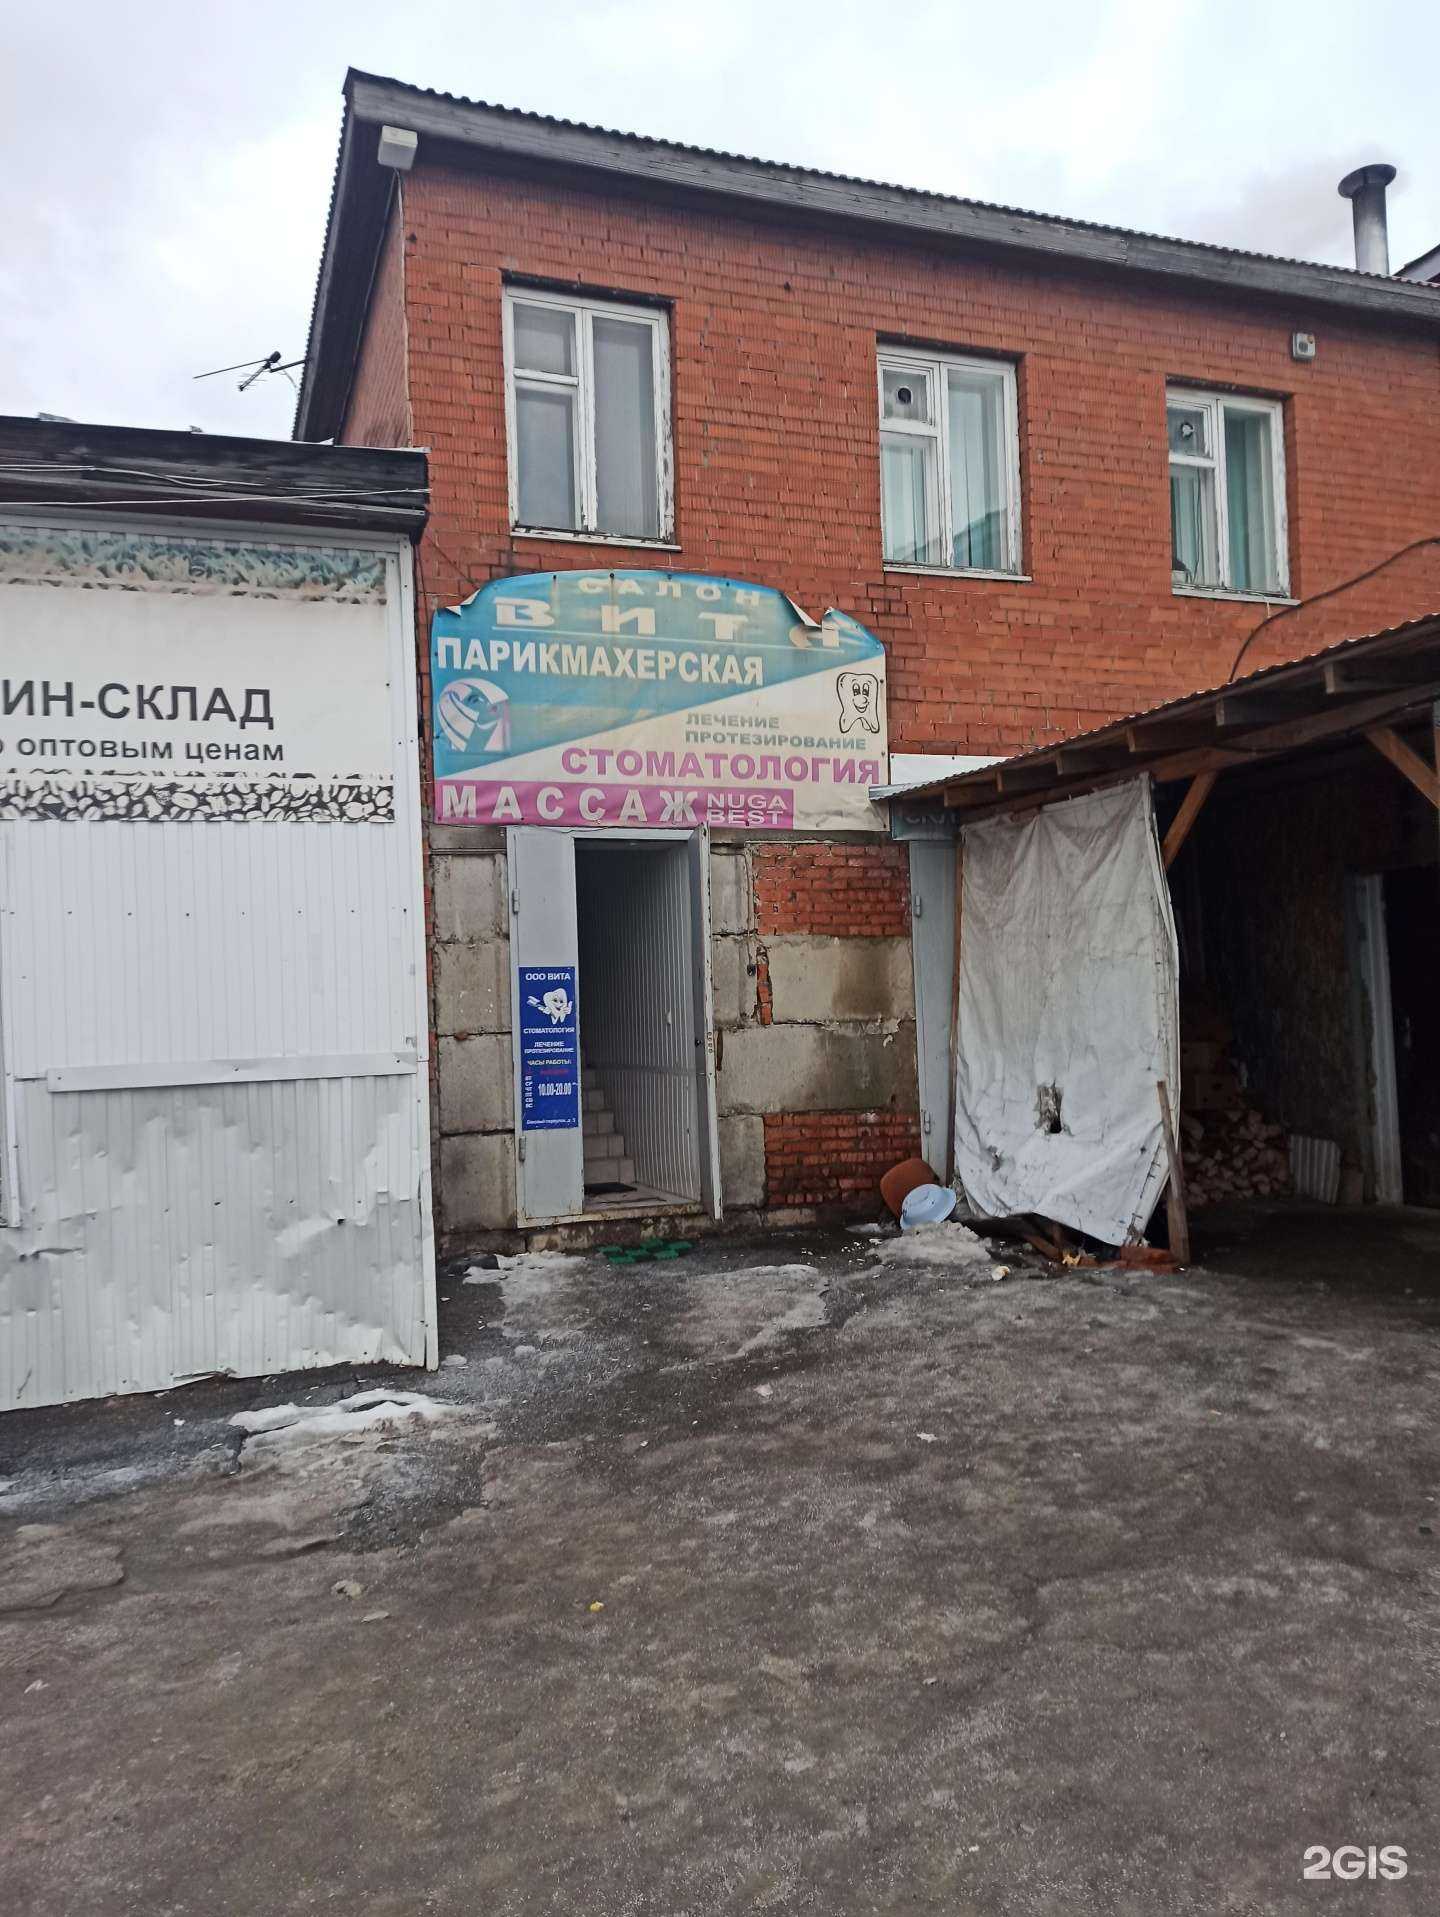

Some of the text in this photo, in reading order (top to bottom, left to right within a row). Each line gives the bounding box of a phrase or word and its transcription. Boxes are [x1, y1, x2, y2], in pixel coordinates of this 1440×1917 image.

[577, 577, 761, 607] САЛОН
[436, 637, 765, 687] ПАРИКМАХЕРСКАЯ
[685, 712, 781, 730] ЛЕЧЕНИЕ
[16, 737, 173, 759] оптовым
[185, 741, 284, 764] ценам
[684, 730, 868, 751] ПРОТЕЗИРОВАНИЕ
[560, 747, 881, 786] СТОМАТОЛОГИЯ
[441, 784, 699, 824] МАССАЖ
[706, 793, 788, 810] NUGA
[706, 808, 784, 826] BEST
[525, 972, 571, 981] ООО ВИТА
